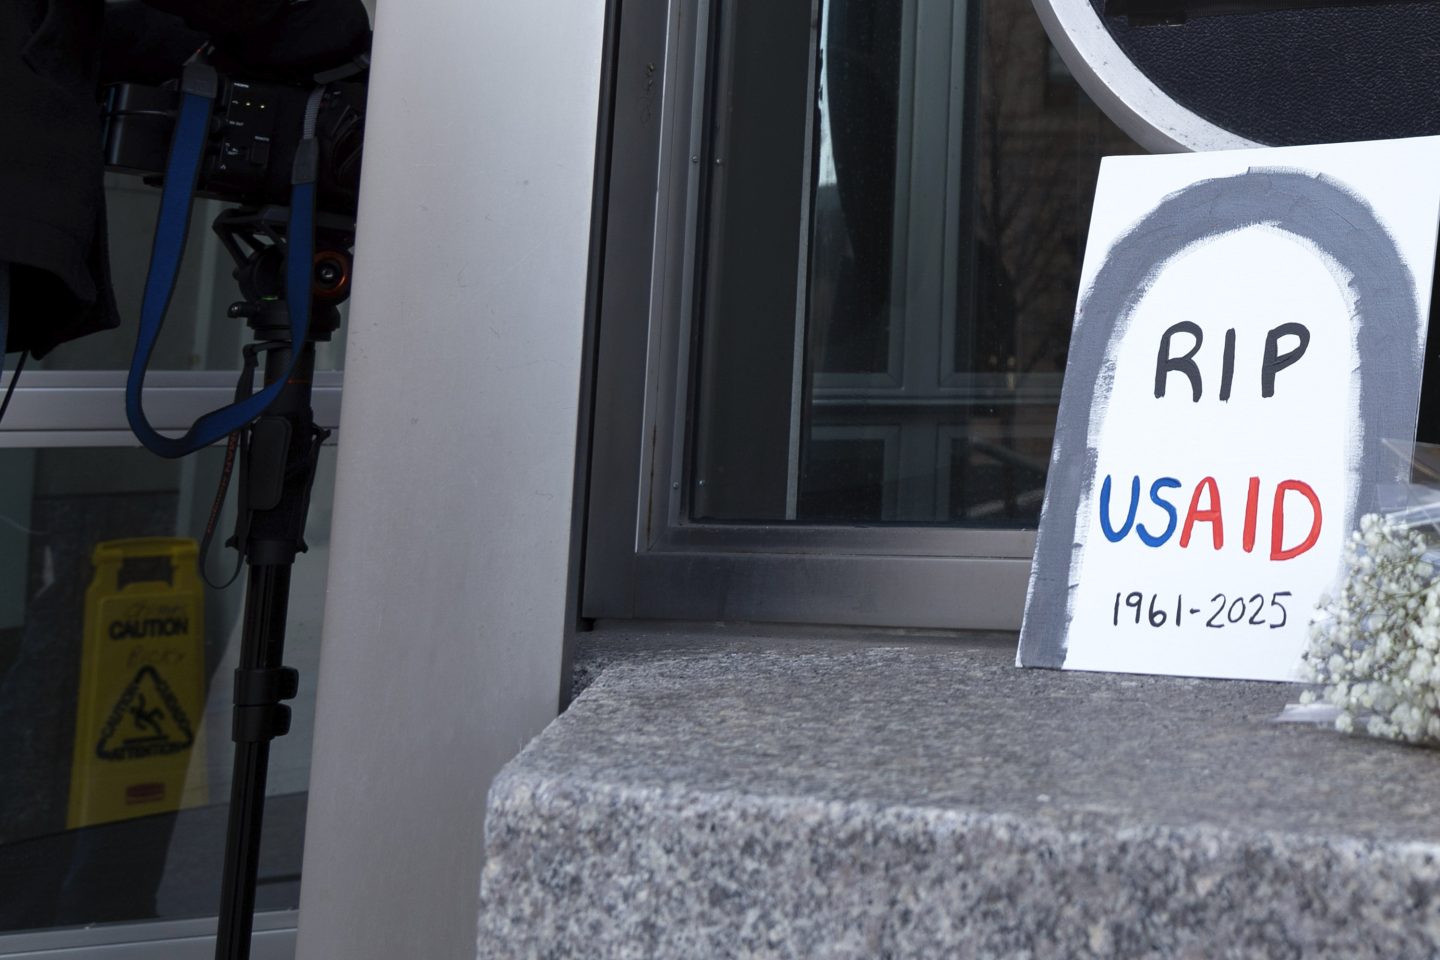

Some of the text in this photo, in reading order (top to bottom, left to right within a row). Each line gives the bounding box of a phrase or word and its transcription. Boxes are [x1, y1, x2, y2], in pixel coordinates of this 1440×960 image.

[1153, 319, 1311, 404] RIP
[1099, 473, 1323, 561] USAID
[109, 617, 189, 641] CAUTION
[1113, 591, 1292, 629] 1961-2025
